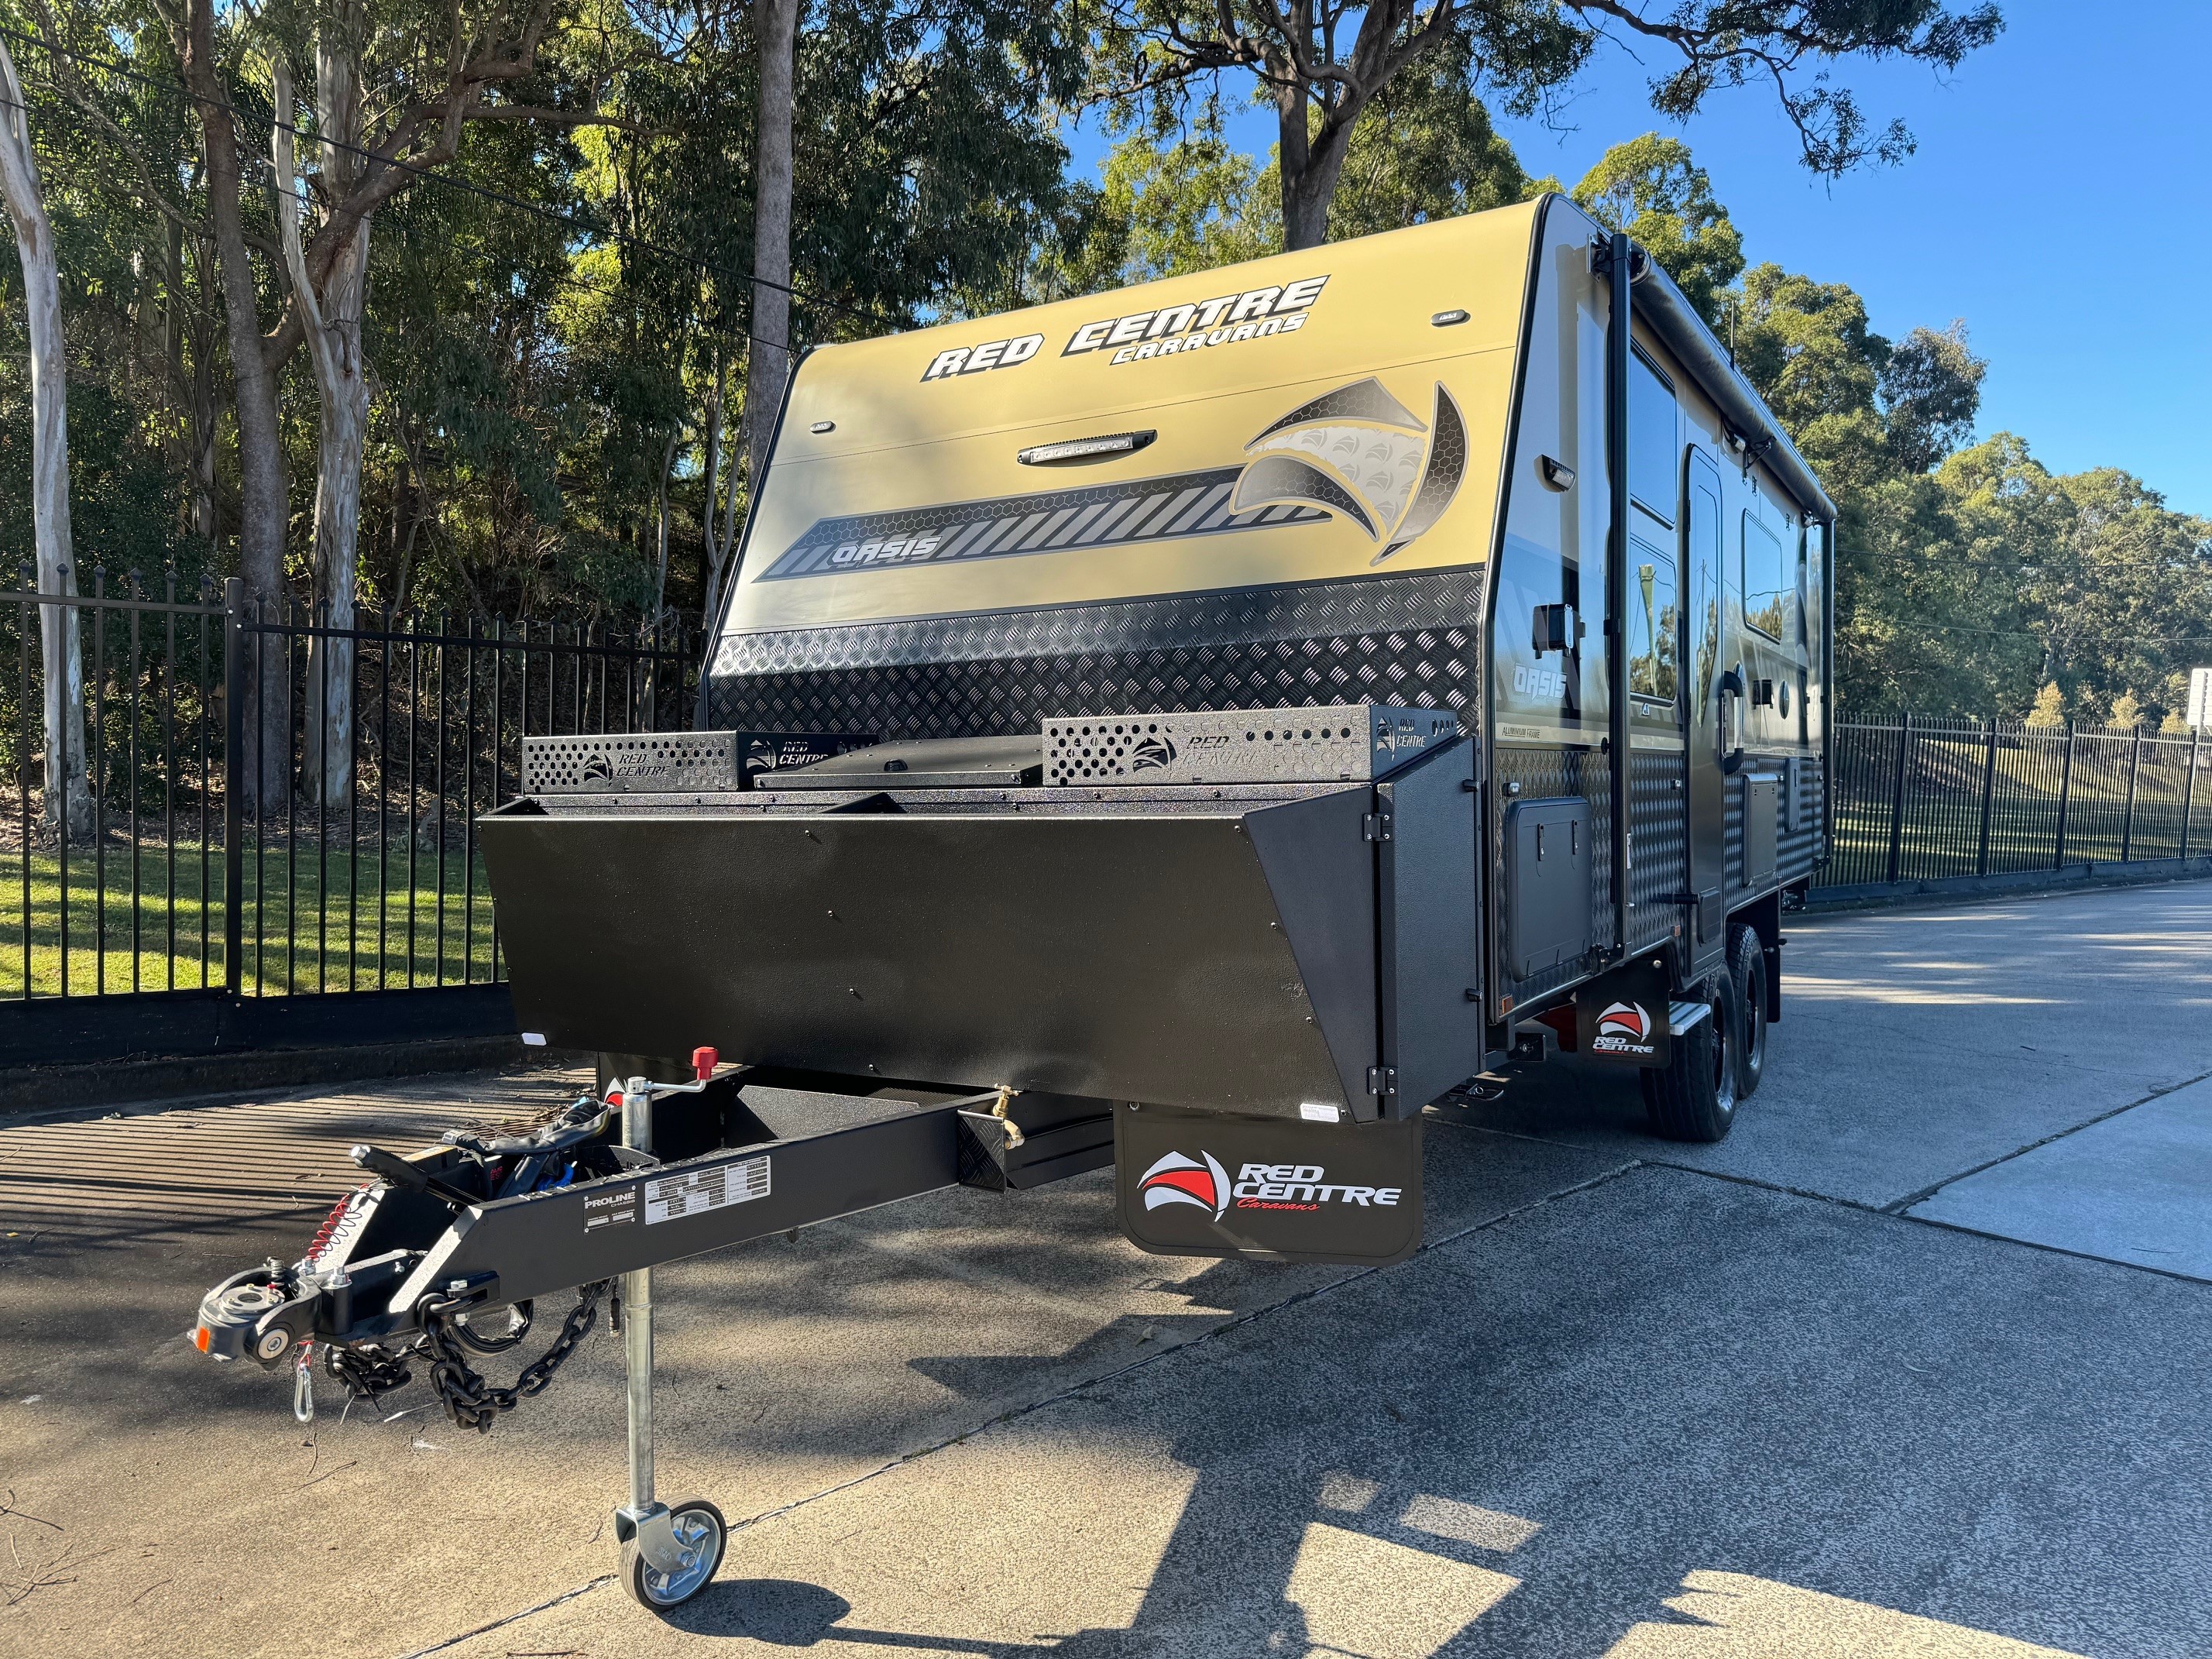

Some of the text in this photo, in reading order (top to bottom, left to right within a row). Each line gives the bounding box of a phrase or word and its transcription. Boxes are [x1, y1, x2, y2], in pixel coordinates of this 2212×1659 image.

[919, 274, 1331, 383] RED CENTRE
[1109, 312, 1310, 366] CARAVANS
[830, 535, 943, 568] OASIS
[1513, 664, 1568, 700] OASIS
[1399, 719, 1415, 732] RED
[783, 741, 809, 752] RED
[1187, 736, 1230, 749] RED
[1396, 735, 1427, 747] CENTRE
[619, 754, 647, 764] RED
[617, 766, 672, 777] CENTRE
[1595, 1036, 1626, 1045] RED
[1592, 1043, 1654, 1053] CENTRE
[1238, 1163, 1324, 1183] RED
[585, 1191, 636, 1209] PROLINE
[1232, 1182, 1403, 1207] CENTRE
[1235, 1197, 1321, 1211] Caravans
